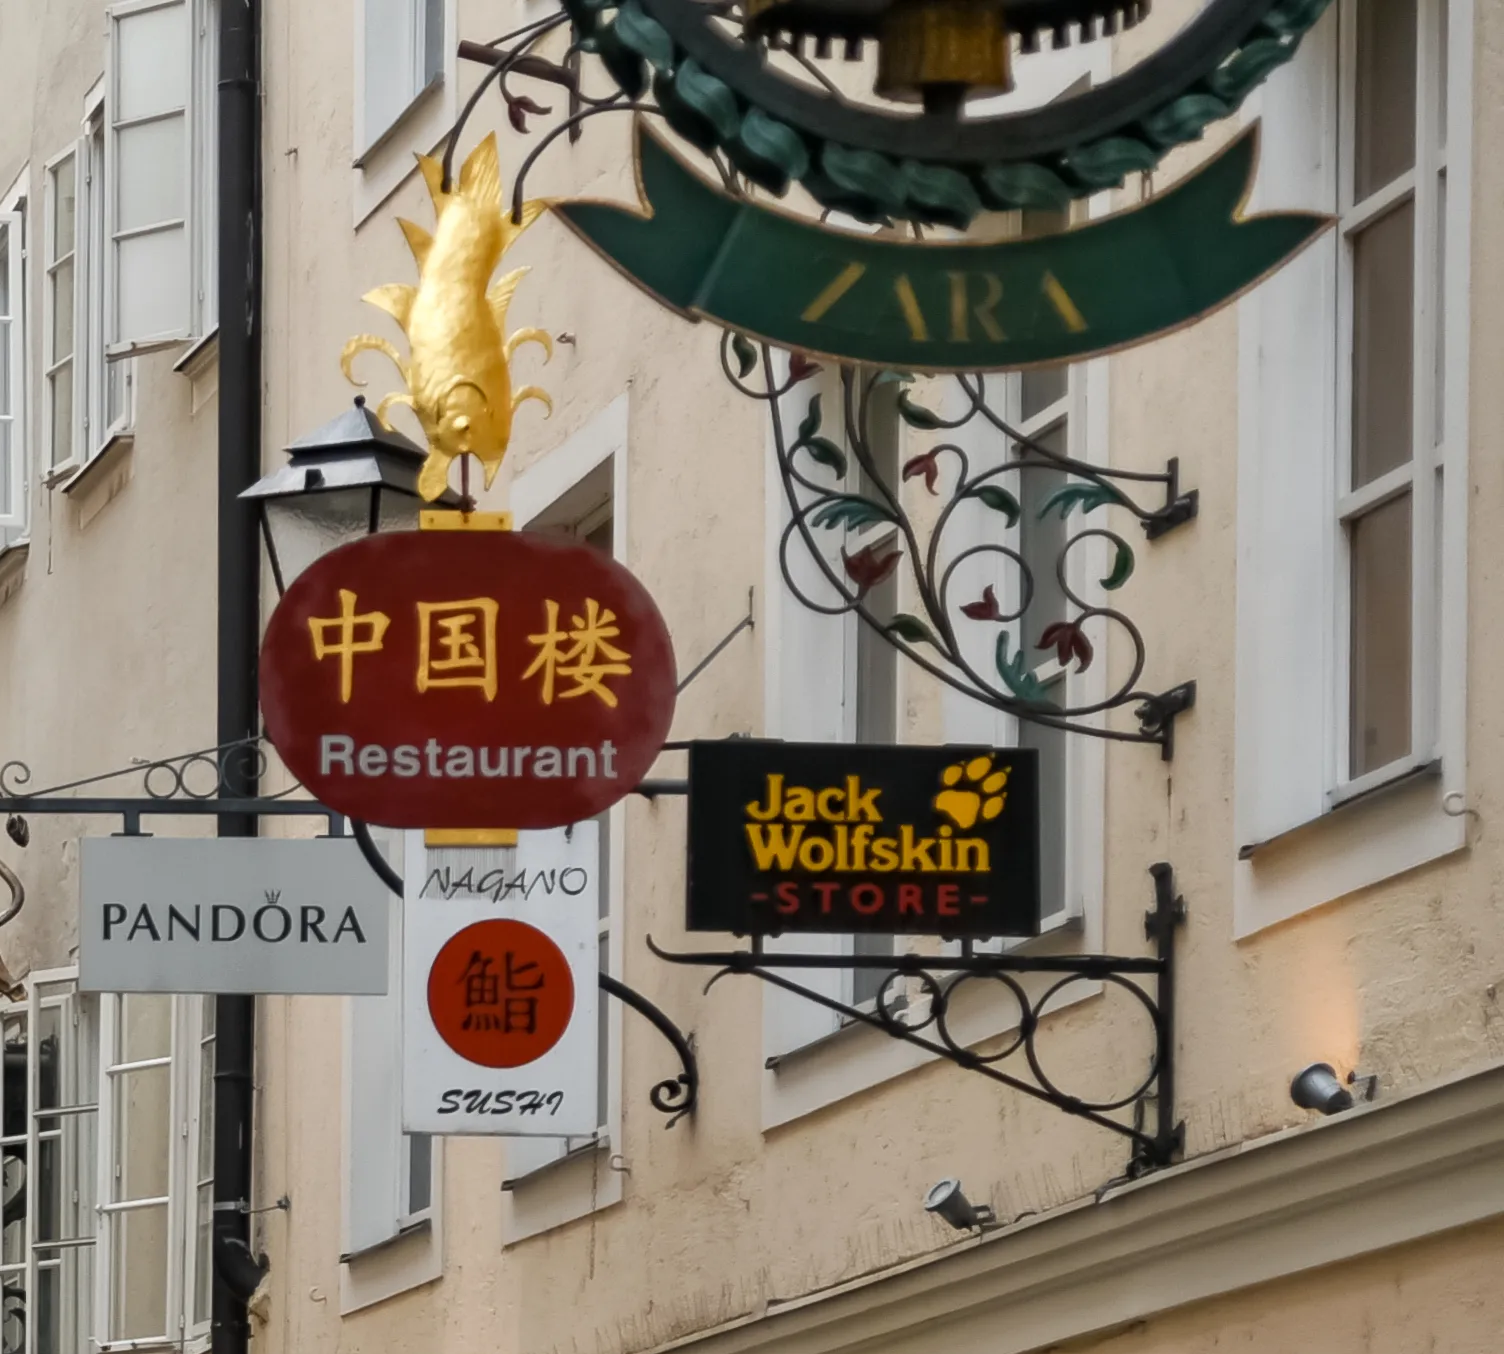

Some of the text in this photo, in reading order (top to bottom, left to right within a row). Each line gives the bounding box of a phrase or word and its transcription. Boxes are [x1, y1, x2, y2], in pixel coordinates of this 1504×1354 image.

[800, 262, 1089, 342] ZARA
[307, 588, 633, 707] 中国楼
[320, 734, 618, 779] Restaurant
[745, 773, 884, 821] Jack
[744, 823, 990, 872] Wolfskin
[419, 865, 588, 903] NAGANO
[101, 903, 367, 944] PANDORA
[455, 949, 546, 1036] 鮨
[437, 1089, 564, 1117] SUSHI
